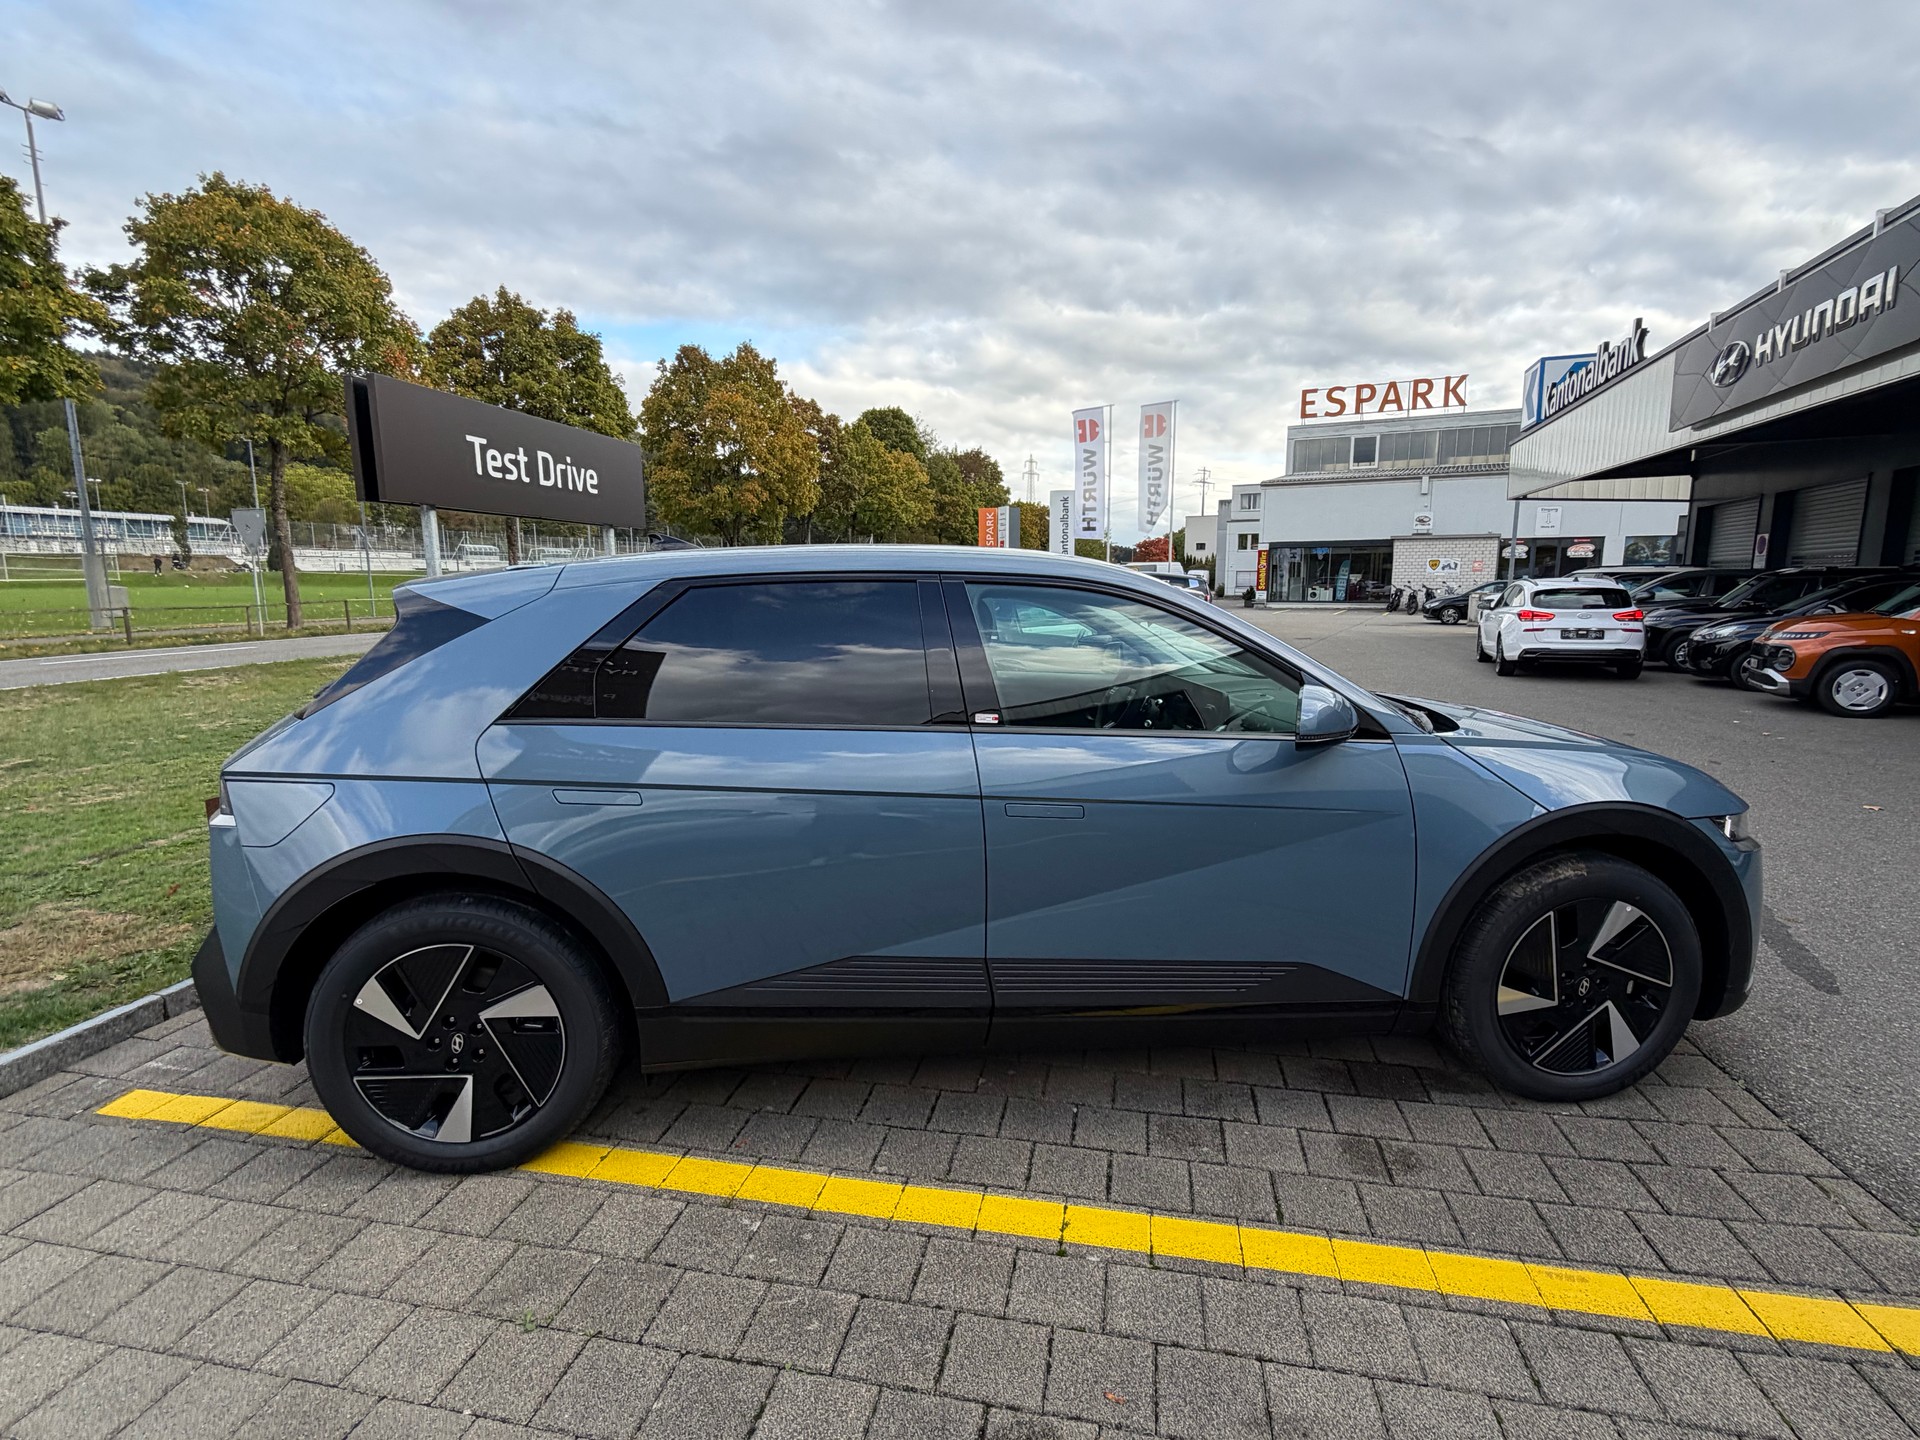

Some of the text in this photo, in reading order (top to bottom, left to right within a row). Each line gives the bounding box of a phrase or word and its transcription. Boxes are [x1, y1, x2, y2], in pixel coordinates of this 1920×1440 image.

[1755, 265, 1899, 367] HYUNDAI
[1301, 374, 1469, 419] ESPARK
[1541, 318, 1650, 420] Kantonalbank
[465, 434, 599, 494] Test Drive
[986, 512, 994, 547] SPARK
[1060, 495, 1069, 555] antonalbank
